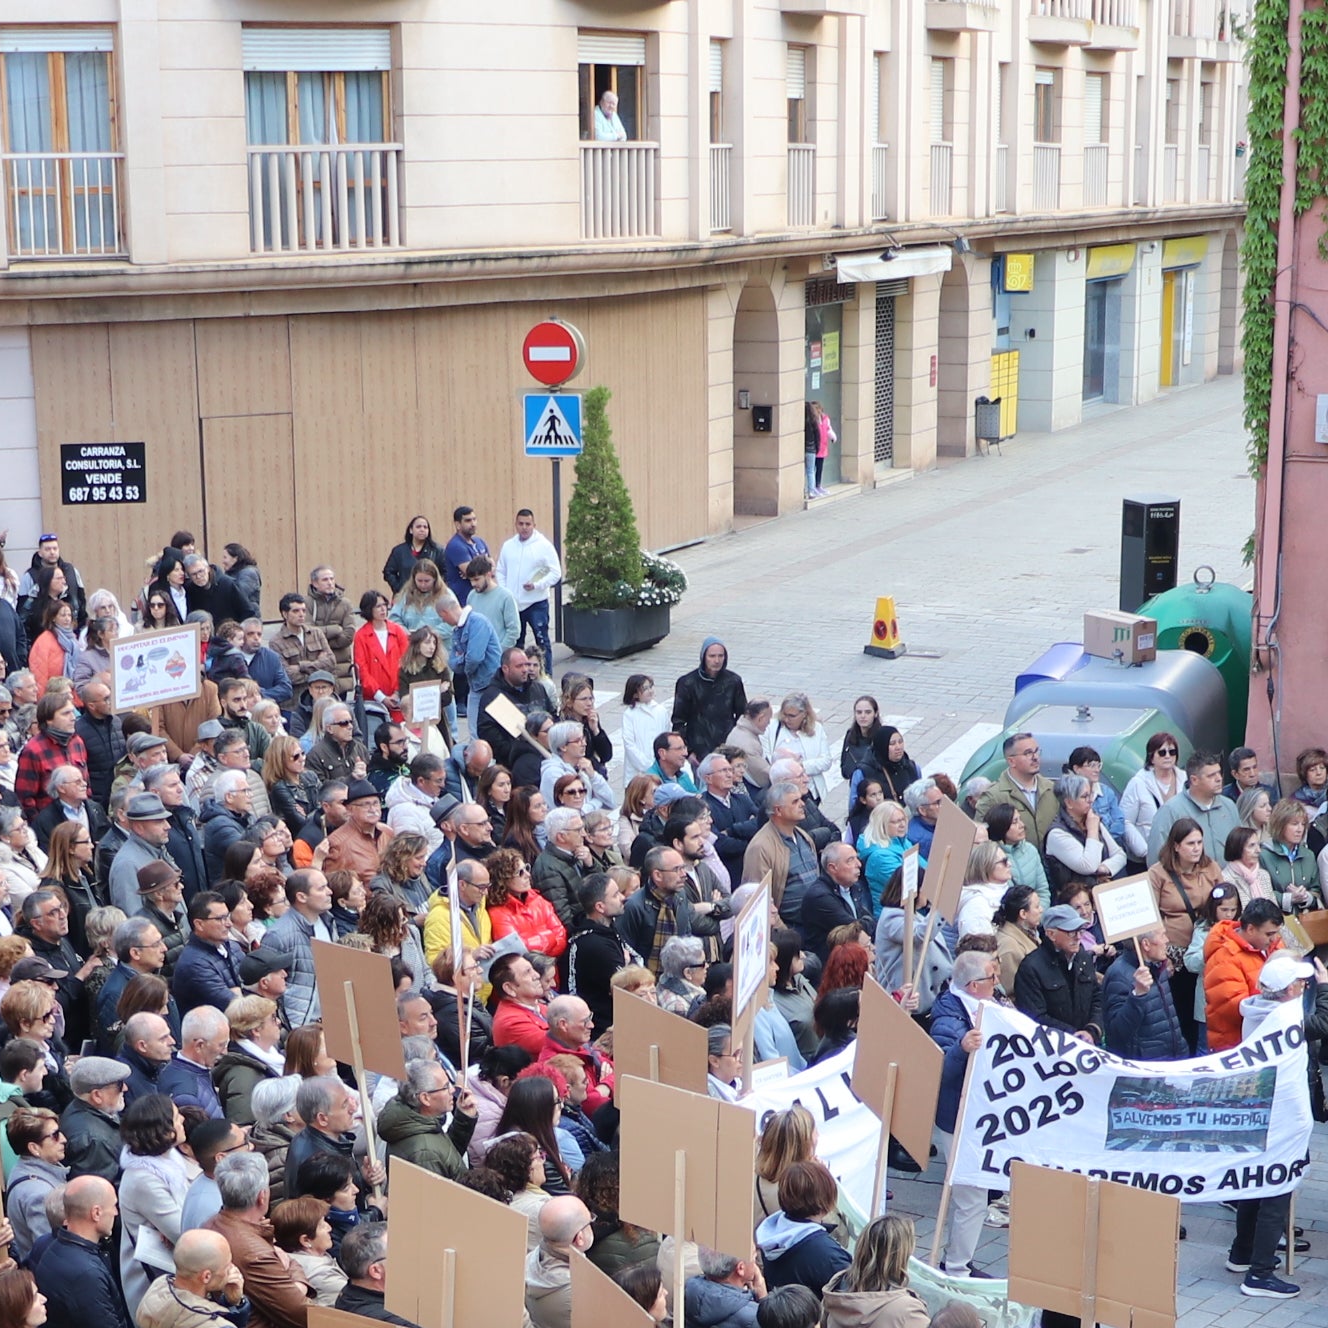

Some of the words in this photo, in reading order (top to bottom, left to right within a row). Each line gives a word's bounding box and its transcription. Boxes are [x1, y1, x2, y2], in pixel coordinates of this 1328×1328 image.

[80, 446, 126, 457] CARRANZA
[65, 459, 125, 470] CONSULTORIA,
[126, 458, 142, 469] S.L.
[85, 473, 122, 484] VENDE
[69, 487, 90, 501] 687
[92, 486, 107, 501] 95
[109, 486, 123, 500] 43
[125, 485, 140, 500] 53
[985, 1023, 1078, 1069] 2012
[984, 1066, 1026, 1103] LO
[976, 1081, 1085, 1147] 2025
[1113, 1111, 1183, 1126] SALVEMOS
[1186, 1111, 1208, 1125] TU
[1212, 1111, 1269, 1126] HOSPITAL
